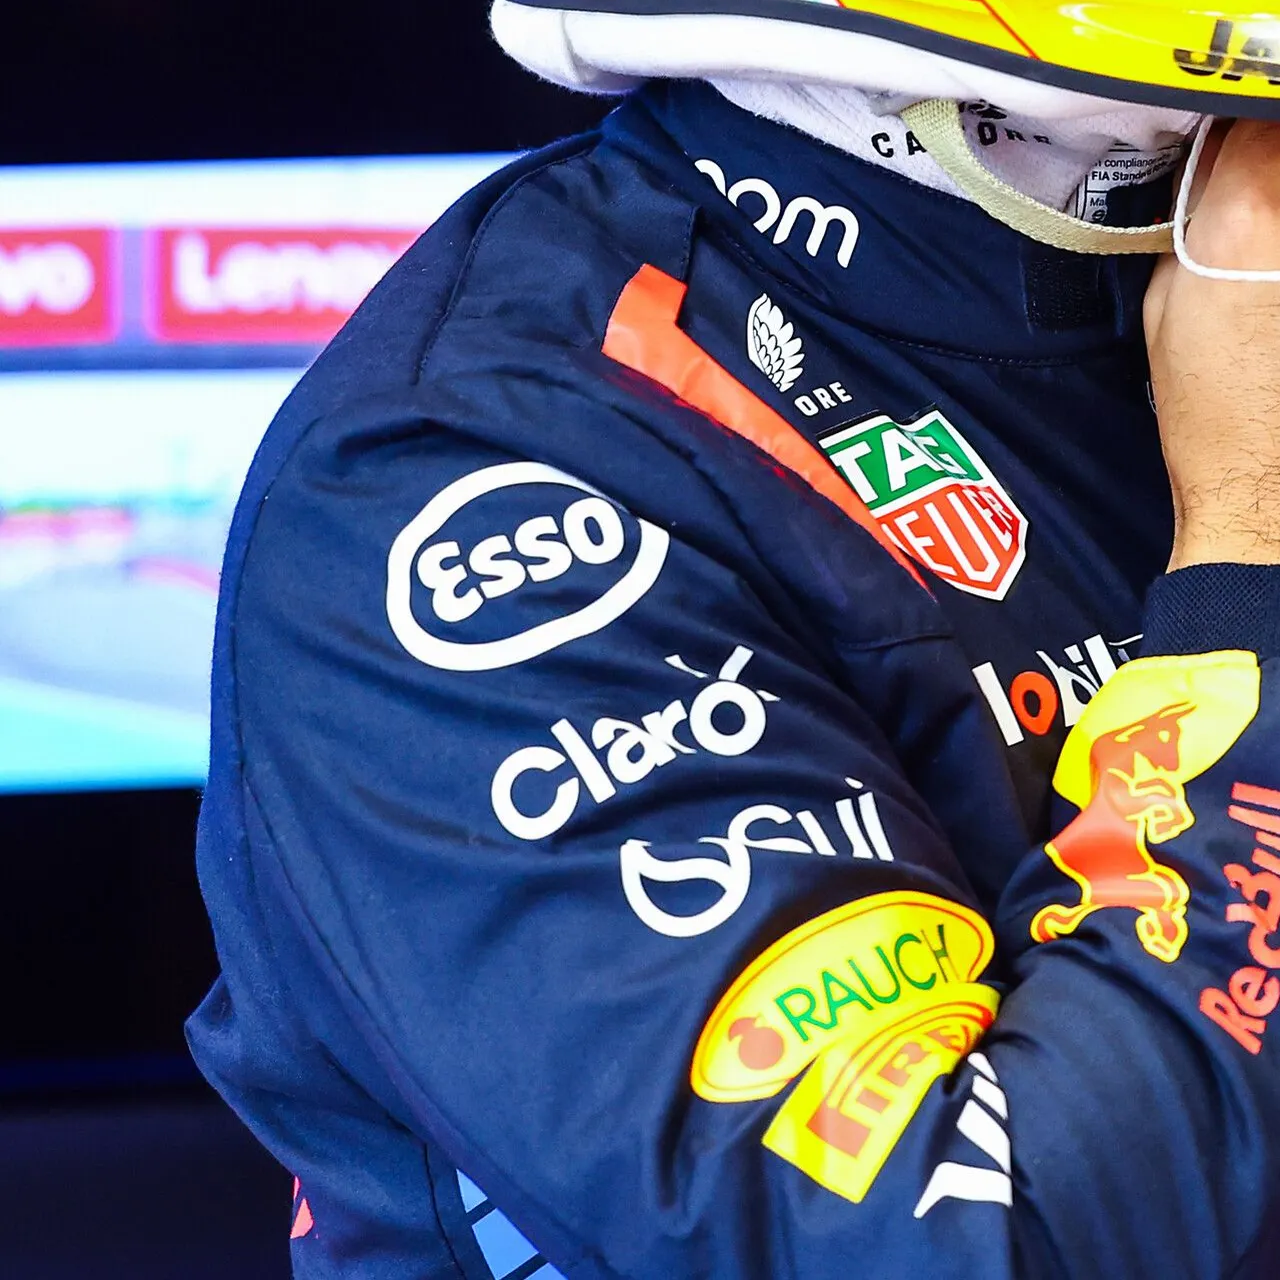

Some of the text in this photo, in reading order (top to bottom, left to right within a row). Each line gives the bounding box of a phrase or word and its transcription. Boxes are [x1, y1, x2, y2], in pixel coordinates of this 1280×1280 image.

[1091, 170, 1110, 181] FIA
[416, 496, 625, 622] Esso
[490, 675, 767, 841] Claro
[774, 923, 961, 1042] RAUCH
